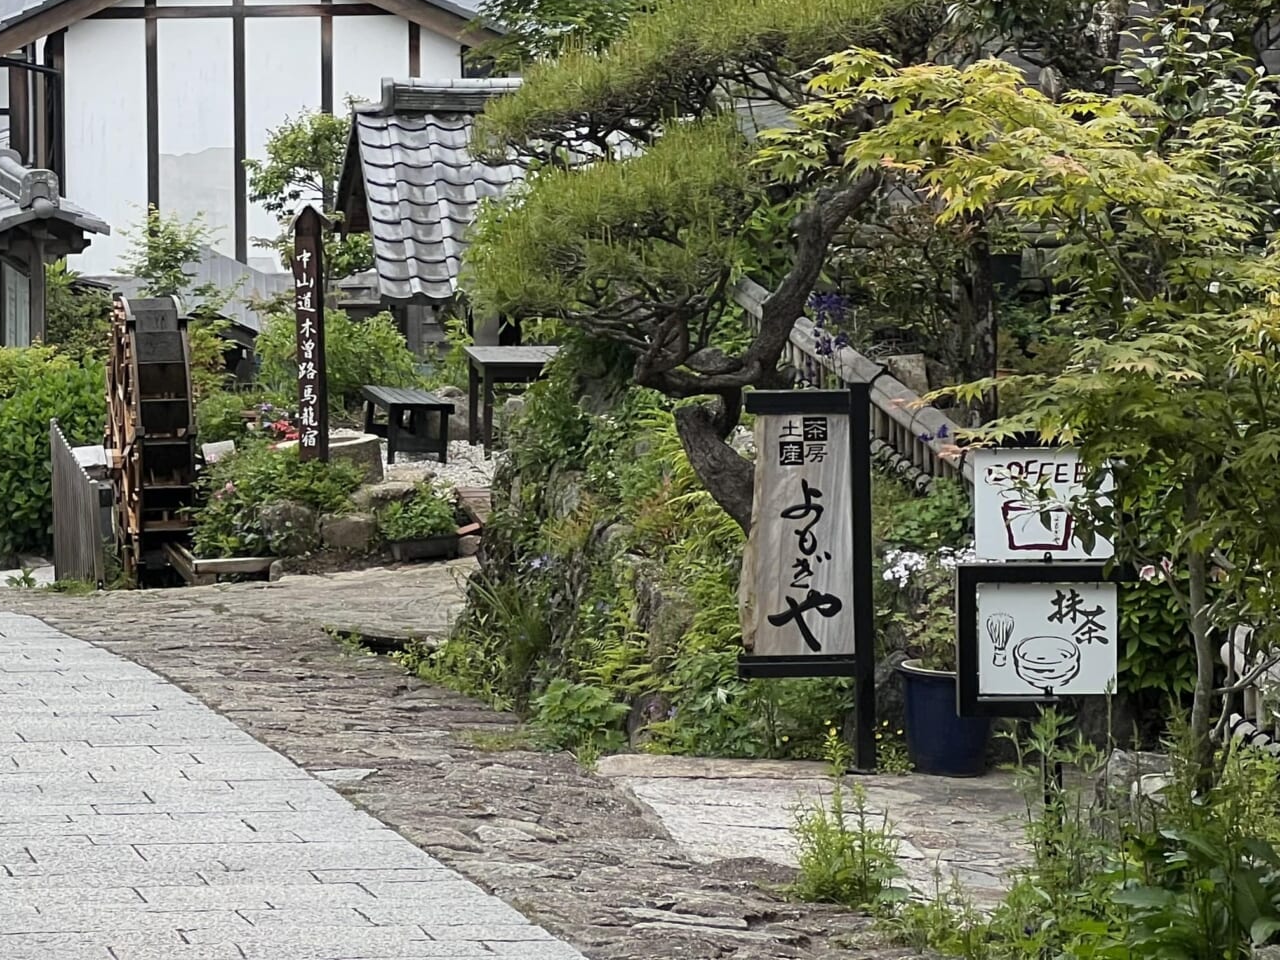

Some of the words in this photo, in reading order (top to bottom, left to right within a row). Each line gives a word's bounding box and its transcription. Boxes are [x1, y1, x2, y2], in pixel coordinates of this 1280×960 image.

[778, 419, 804, 465] 土産
[802, 417, 828, 463] 茶房
[767, 478, 843, 652] よもぎや
[1047, 588, 1109, 645] 抹茶
